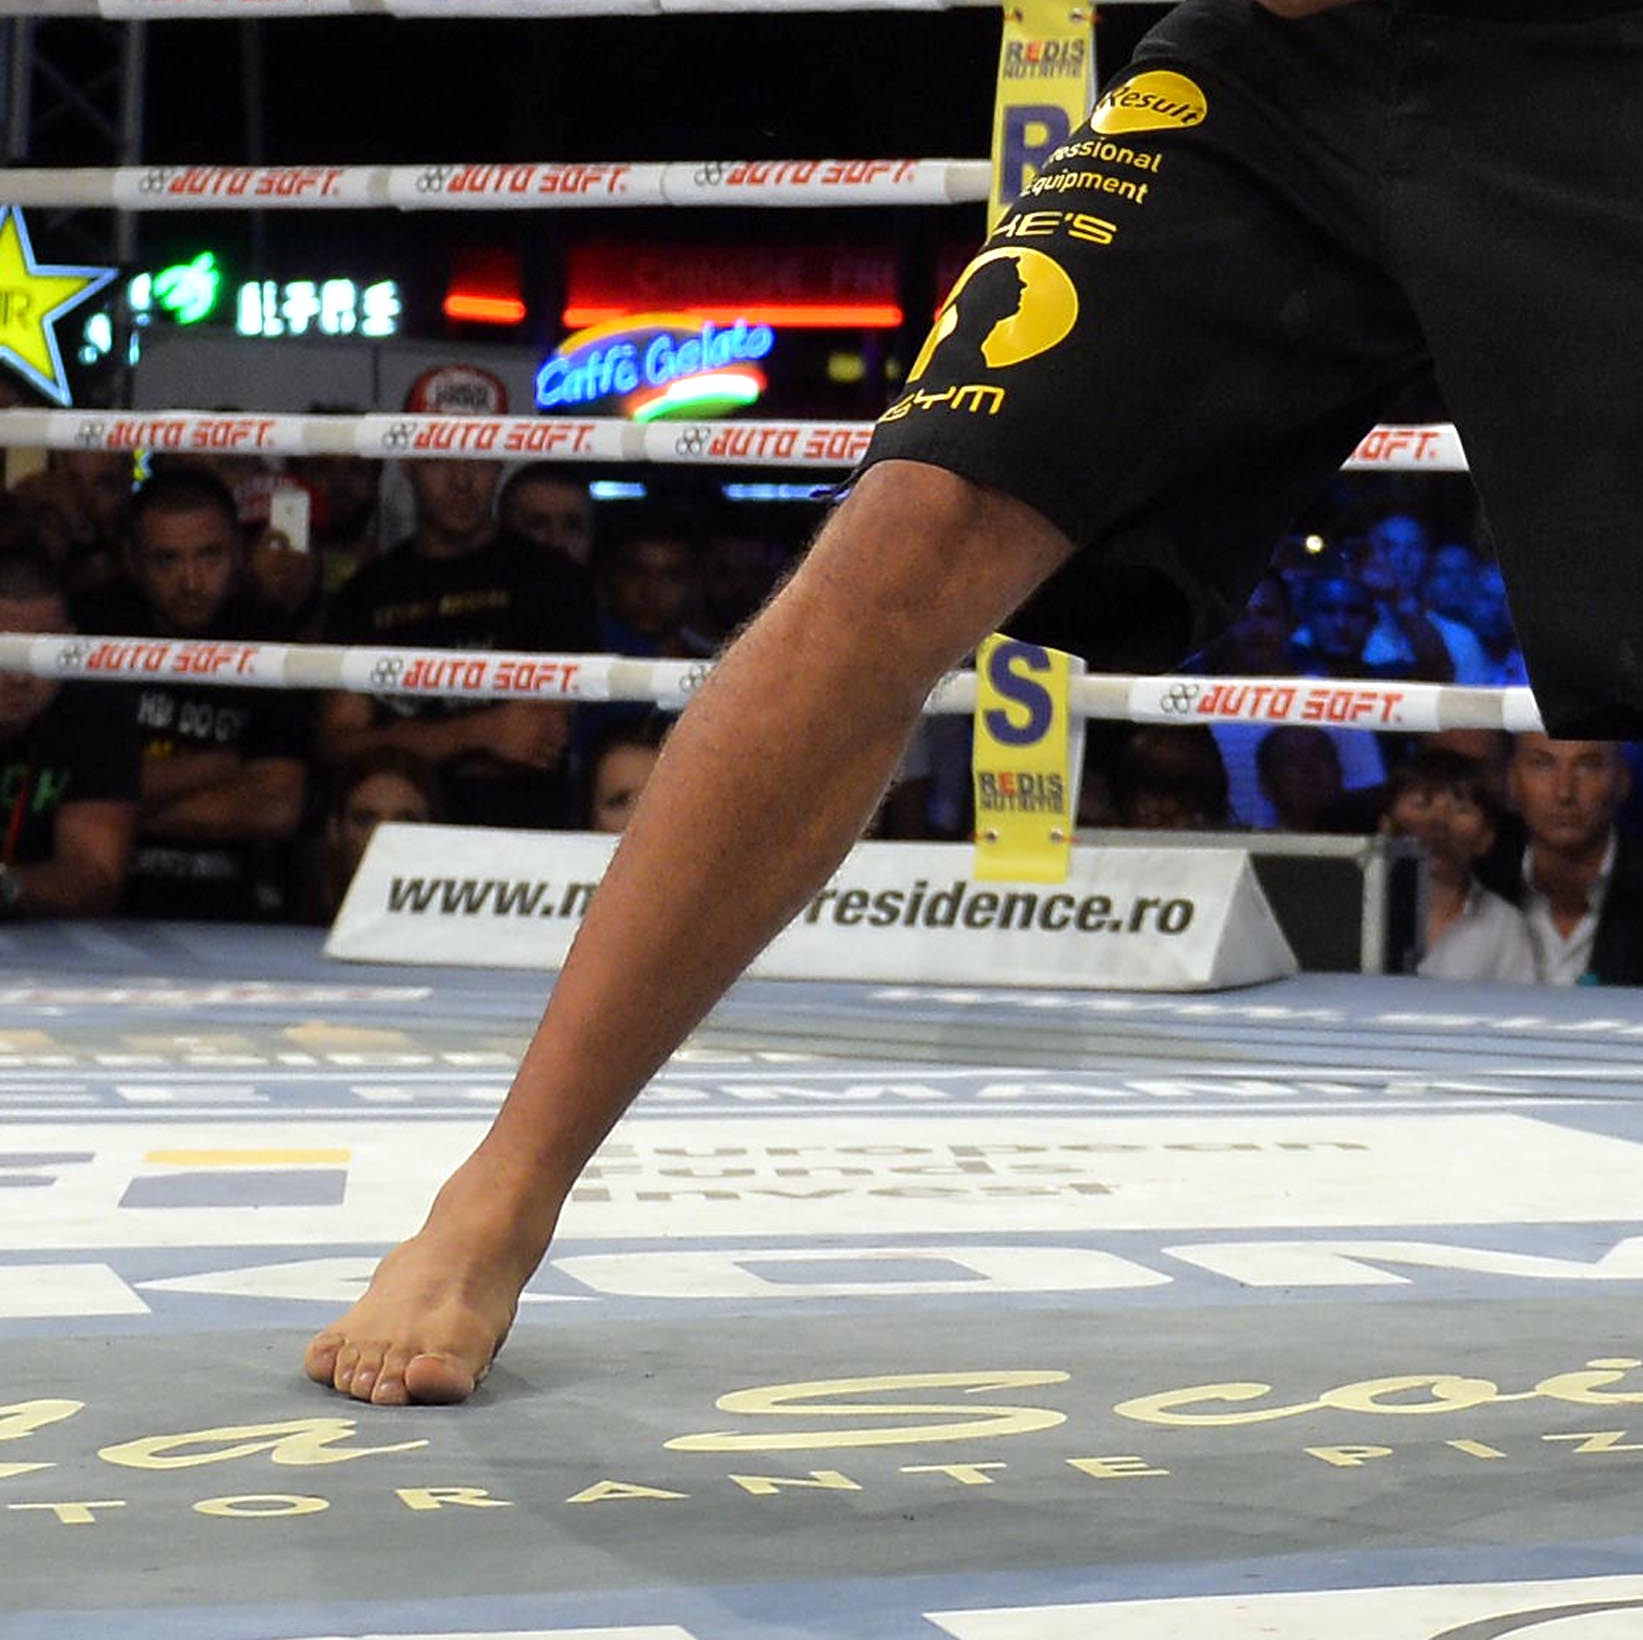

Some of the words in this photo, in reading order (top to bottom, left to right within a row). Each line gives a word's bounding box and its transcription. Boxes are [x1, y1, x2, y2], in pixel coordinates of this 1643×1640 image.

[1006, 39, 1085, 61] REDIS
[645, 322, 776, 385] Gelato
[710, 428, 796, 458] AUTO
[804, 430, 873, 460] SOF
[1354, 430, 1440, 462] OFT
[1197, 684, 1296, 719] AUTO
[979, 771, 1063, 796] REDIS
